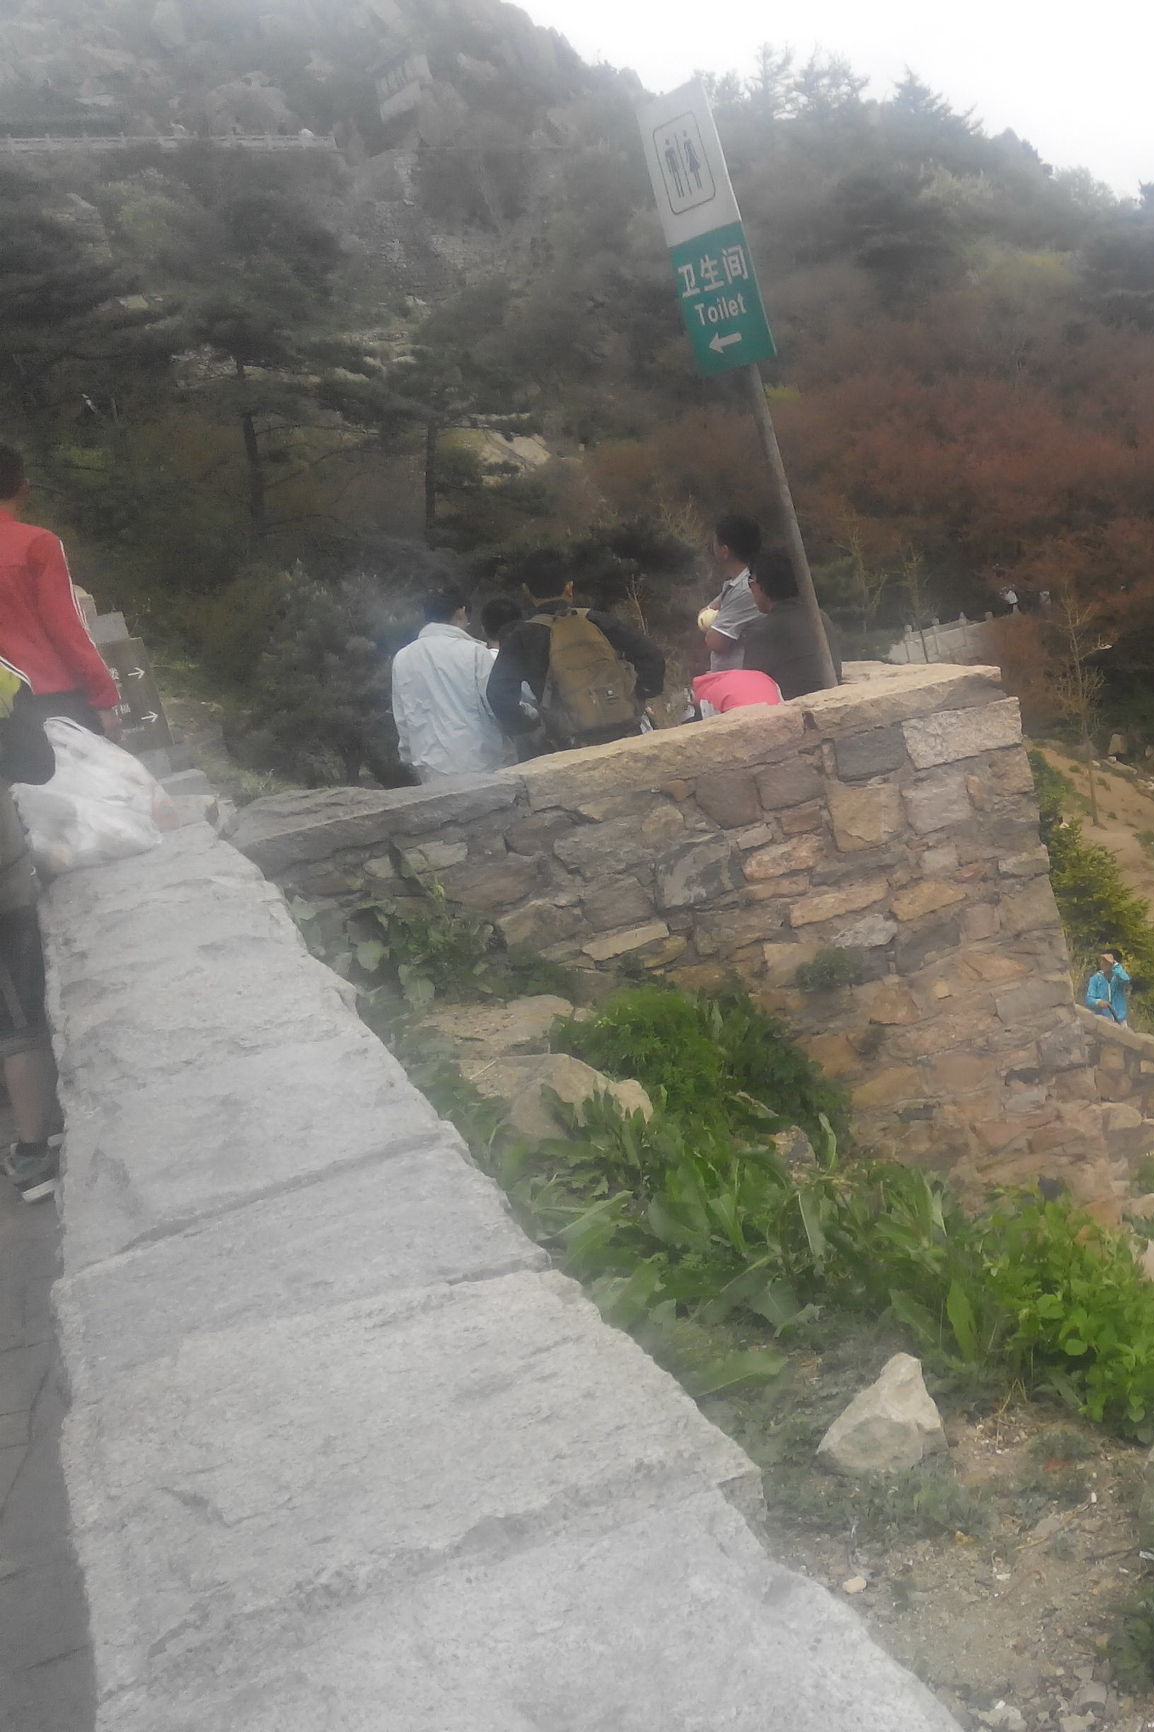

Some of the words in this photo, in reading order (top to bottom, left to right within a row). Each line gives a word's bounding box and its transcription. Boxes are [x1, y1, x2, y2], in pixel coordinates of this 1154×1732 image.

[678, 245, 748, 298] 卫生间
[694, 293, 747, 325] Toilet
